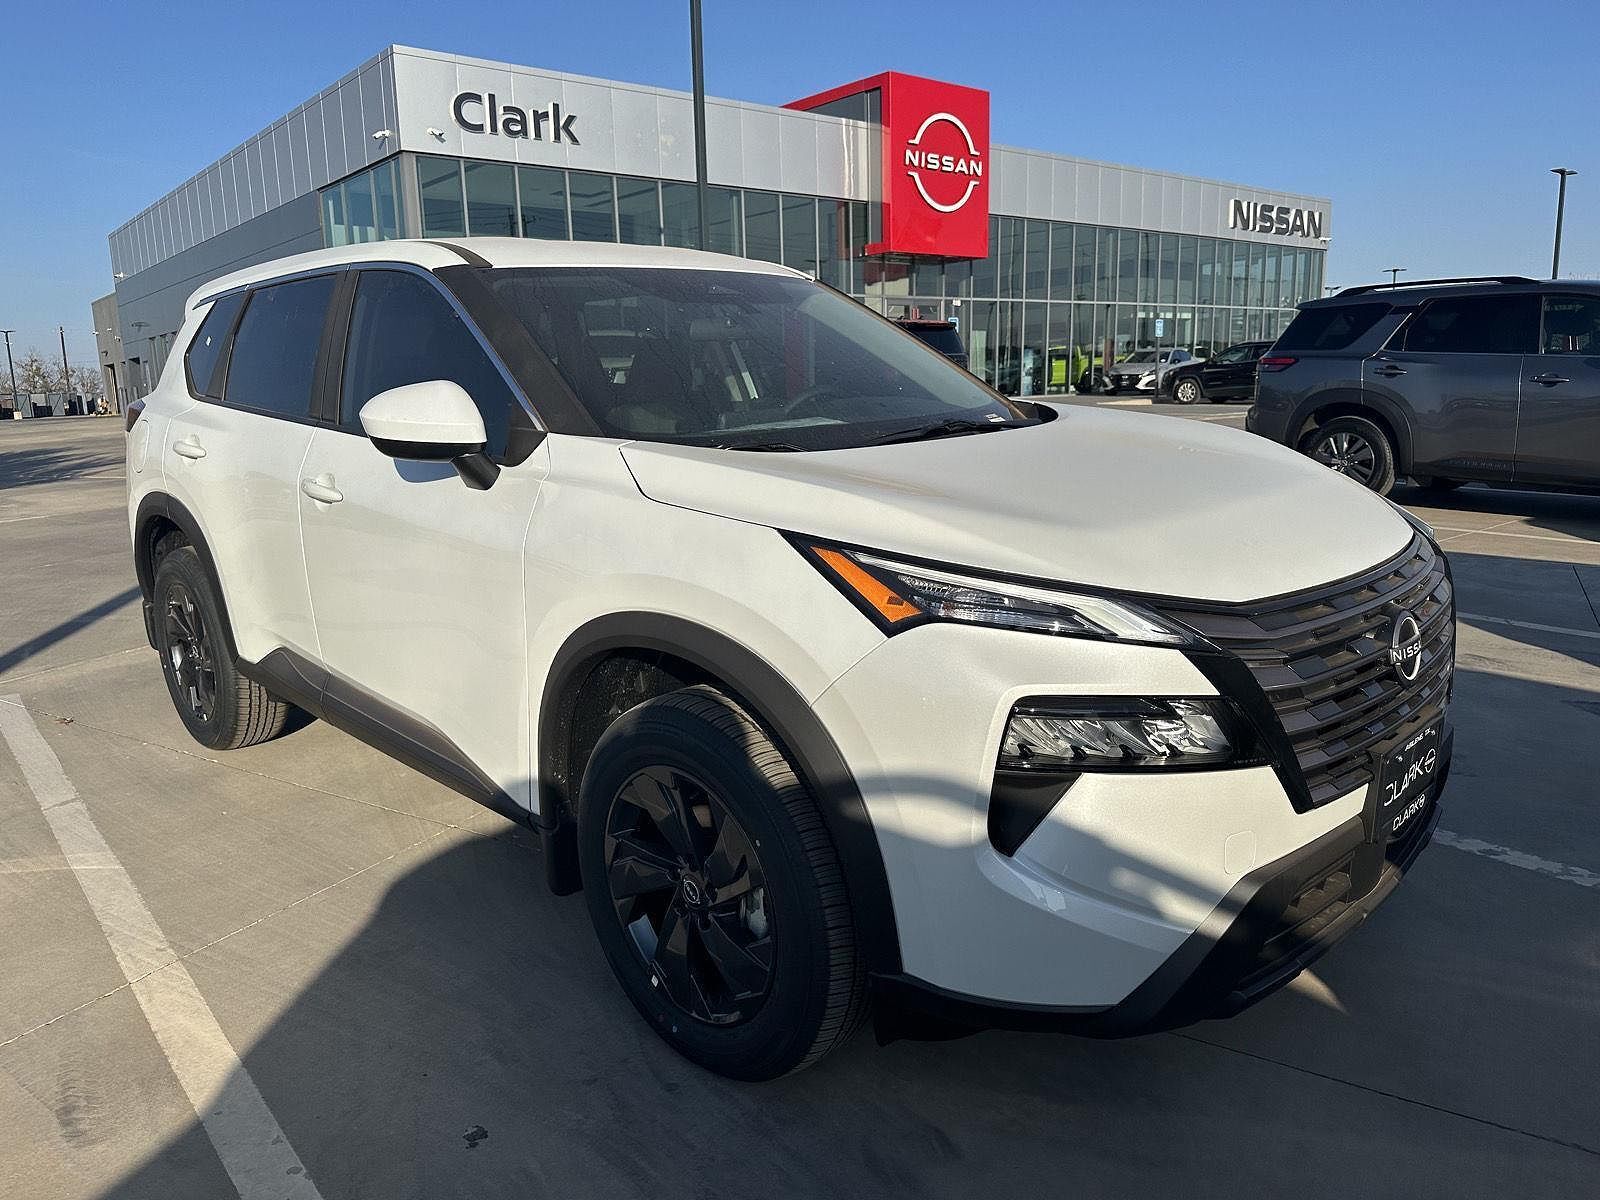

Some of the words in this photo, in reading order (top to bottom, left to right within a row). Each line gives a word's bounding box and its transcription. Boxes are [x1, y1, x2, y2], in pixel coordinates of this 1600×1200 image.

[452, 92, 580, 145] Clark
[905, 149, 982, 176] NISSAN
[1230, 199, 1322, 239] NISSAN
[1392, 801, 1419, 831] CLARK
